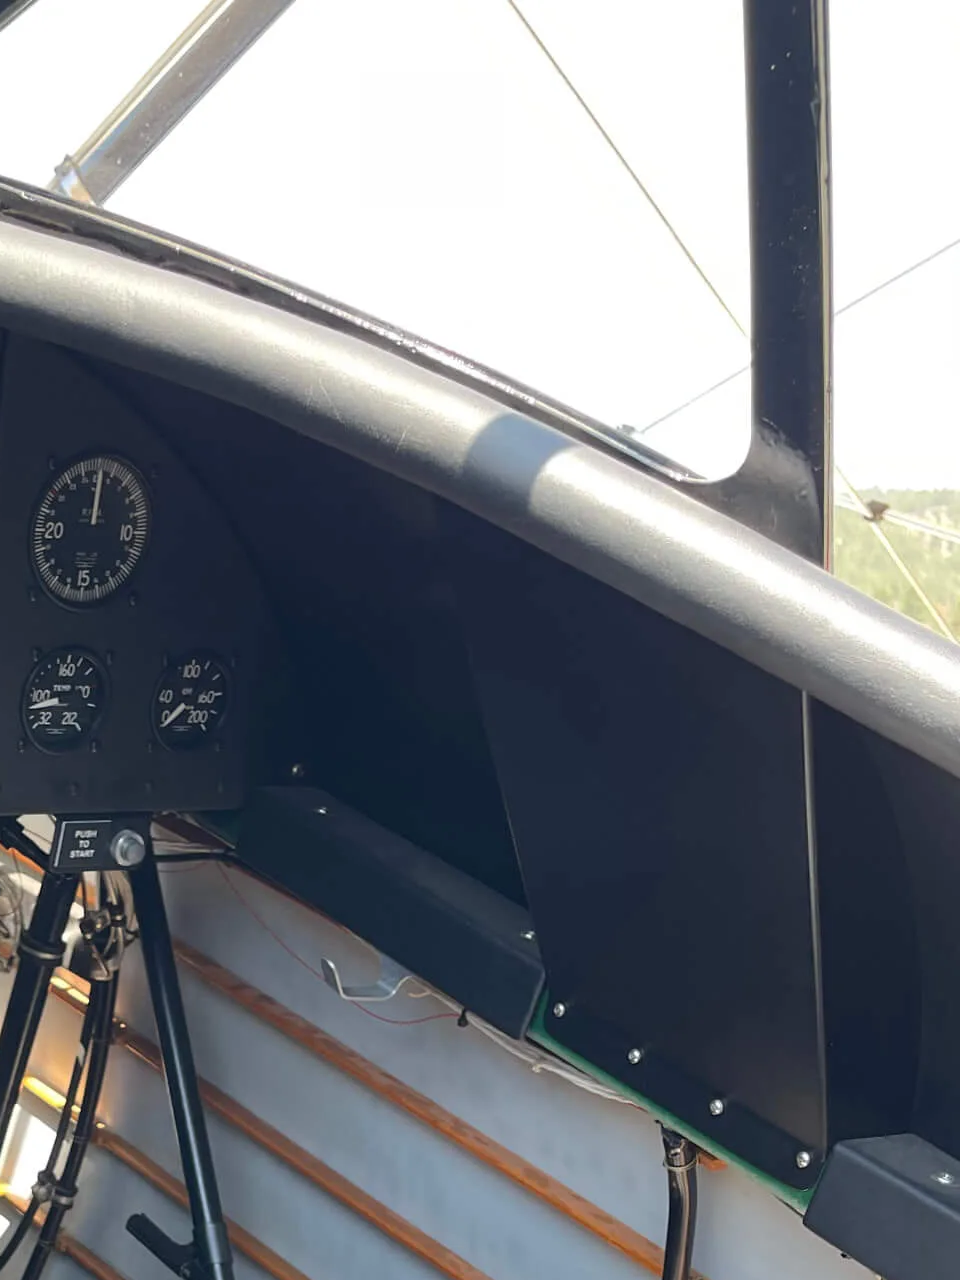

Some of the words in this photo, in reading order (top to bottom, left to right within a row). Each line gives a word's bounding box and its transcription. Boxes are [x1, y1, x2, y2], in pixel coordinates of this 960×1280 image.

[44, 522, 64, 539] 20
[120, 525, 133, 541] 10
[77, 569, 90, 586] 15
[58, 664, 76, 677] 160
[183, 665, 200, 678] 100
[159, 690, 173, 703] 40
[39, 712, 52, 725] 32
[187, 710, 208, 723] 200
[74, 830, 98, 839] PUSH
[79, 840, 90, 848] TO
[69, 849, 96, 859] START
